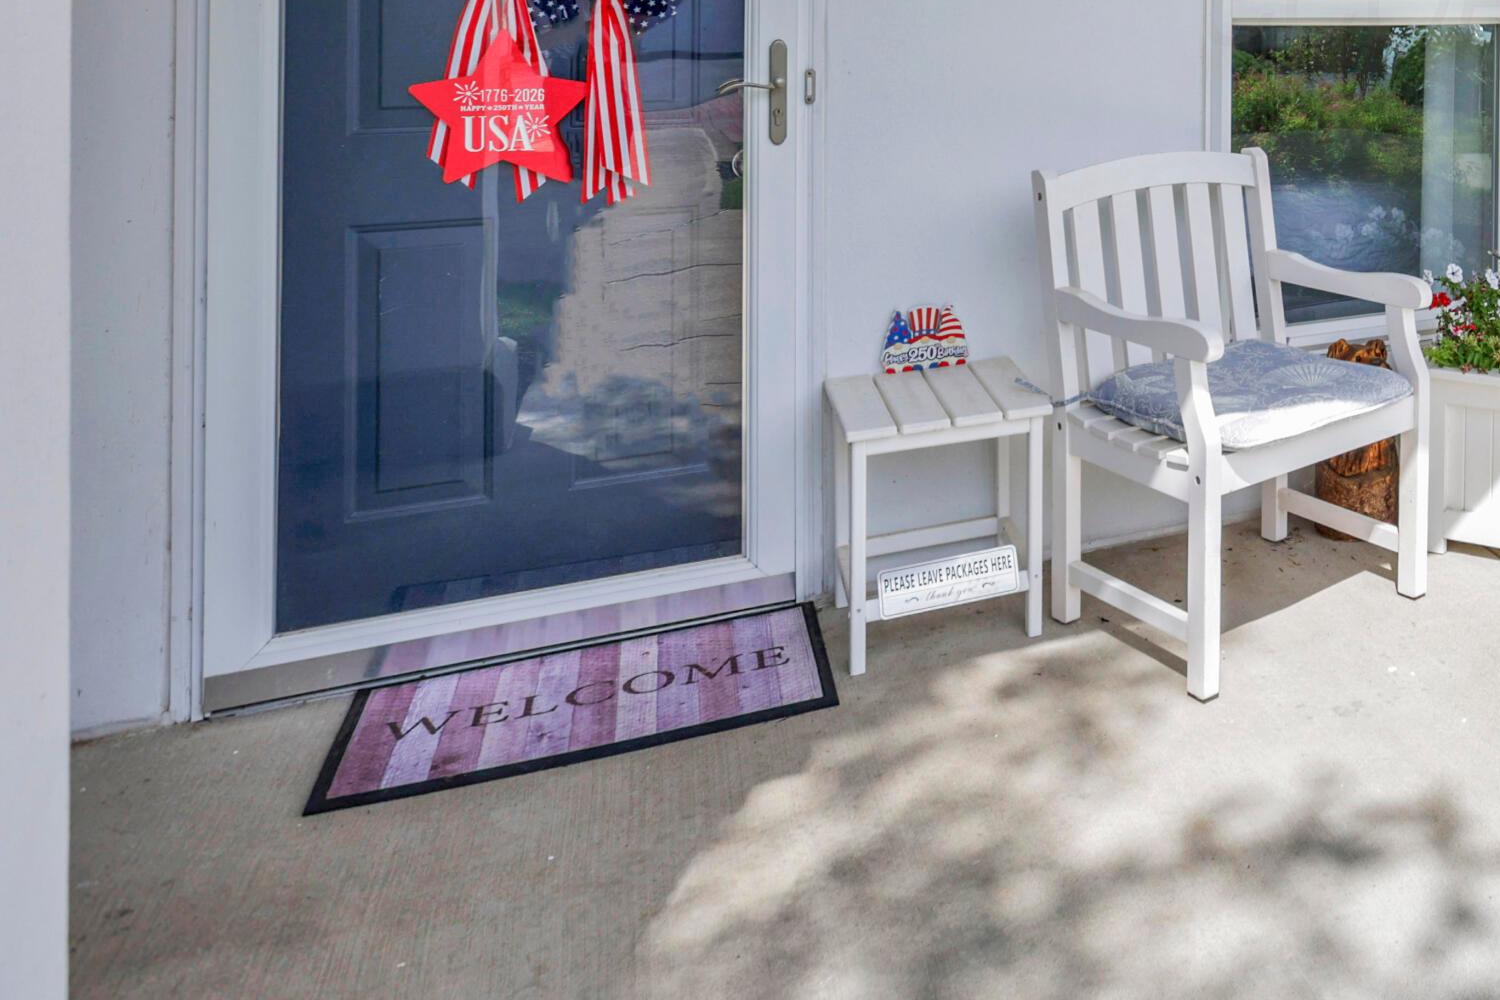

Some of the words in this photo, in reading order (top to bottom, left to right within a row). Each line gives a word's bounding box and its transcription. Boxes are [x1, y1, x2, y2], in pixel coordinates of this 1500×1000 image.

[460, 104, 486, 112] HAPPY
[493, 103, 518, 111] 250TH
[525, 103, 545, 111] YEAR
[480, 88, 545, 102] 1776-2026
[461, 115, 535, 152] USA
[884, 574, 915, 593] PLEASE
[918, 568, 943, 586] LEAVE
[946, 559, 989, 580] PACKAGES
[991, 554, 1012, 572] HERE
[386, 645, 791, 741] WELCOME
